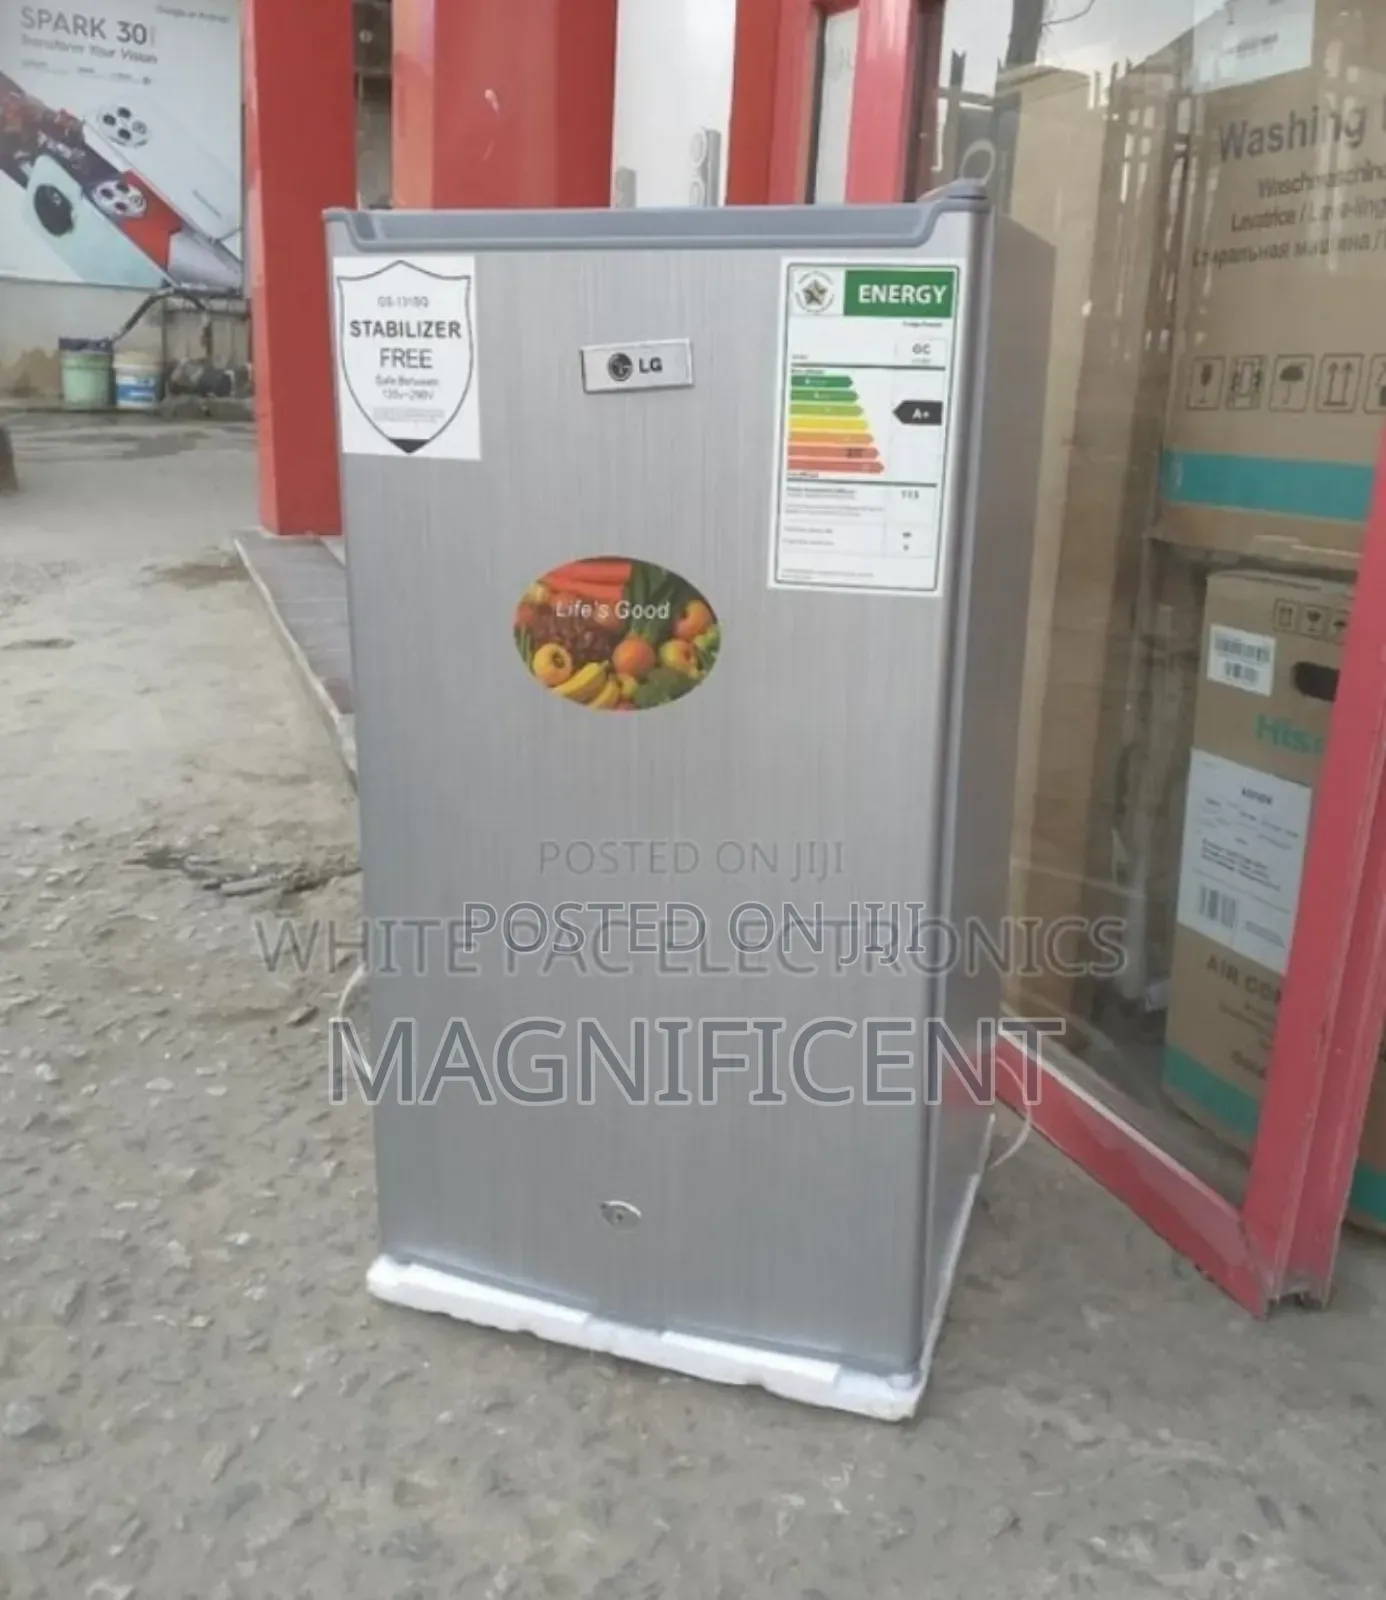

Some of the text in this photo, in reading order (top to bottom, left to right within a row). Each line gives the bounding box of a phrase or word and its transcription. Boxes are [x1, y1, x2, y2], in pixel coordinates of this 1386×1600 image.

[21, 6, 147, 45] SPARK 30
[1220, 104, 1367, 163] Washing
[858, 284, 948, 304] ENERGY
[350, 320, 463, 339] STABILIZER
[379, 347, 433, 369] FREE
[639, 357, 662, 374] LG
[912, 408, 930, 419] A+
[556, 600, 670, 619] Life's Good
[1207, 953, 1239, 985] AIR
